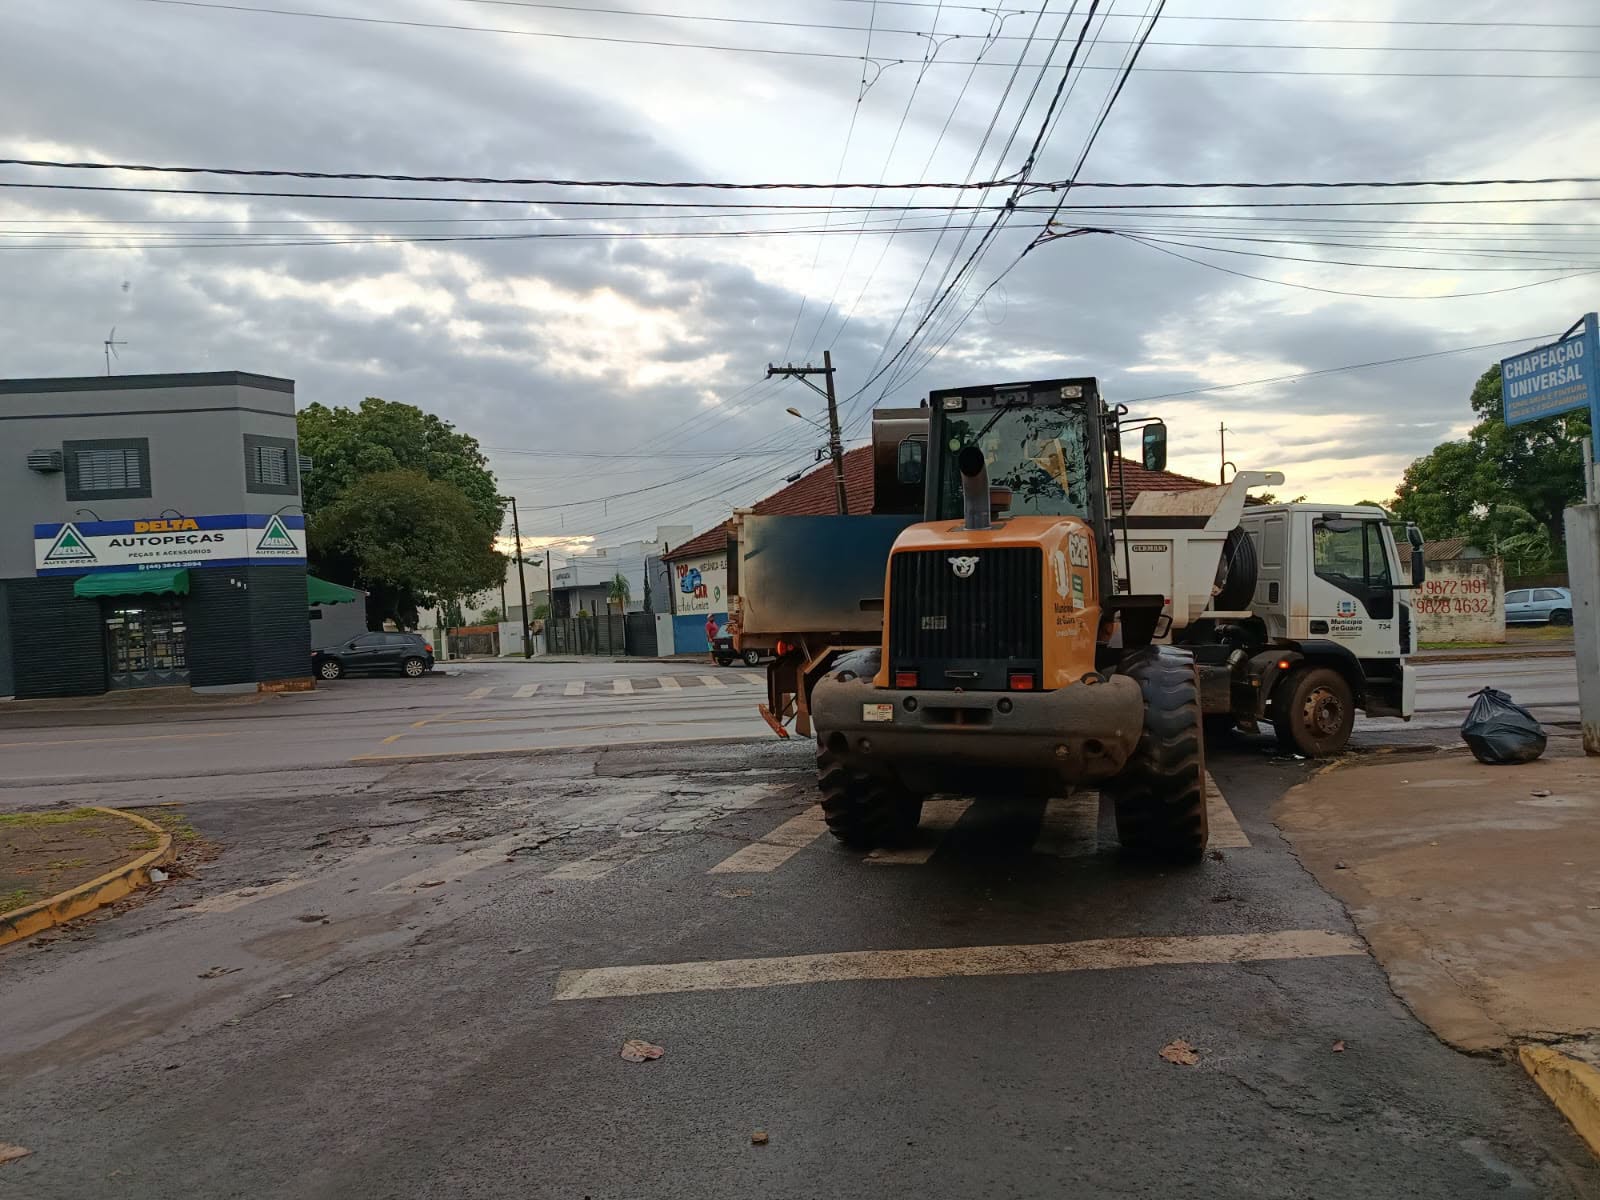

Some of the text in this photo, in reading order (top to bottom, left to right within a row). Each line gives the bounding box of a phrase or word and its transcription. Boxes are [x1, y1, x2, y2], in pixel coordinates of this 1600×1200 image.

[1505, 341, 1583, 379] CHAPEAÇÃO
[1510, 364, 1582, 398] UNIVERSAL
[134, 519, 199, 532] DELTA
[109, 534, 224, 547] AUTOPEÇAS
[676, 564, 689, 579] TOP
[694, 584, 708, 599] CAR
[1426, 581, 1457, 595] 9872
[1416, 598, 1488, 613] 9828 4632
